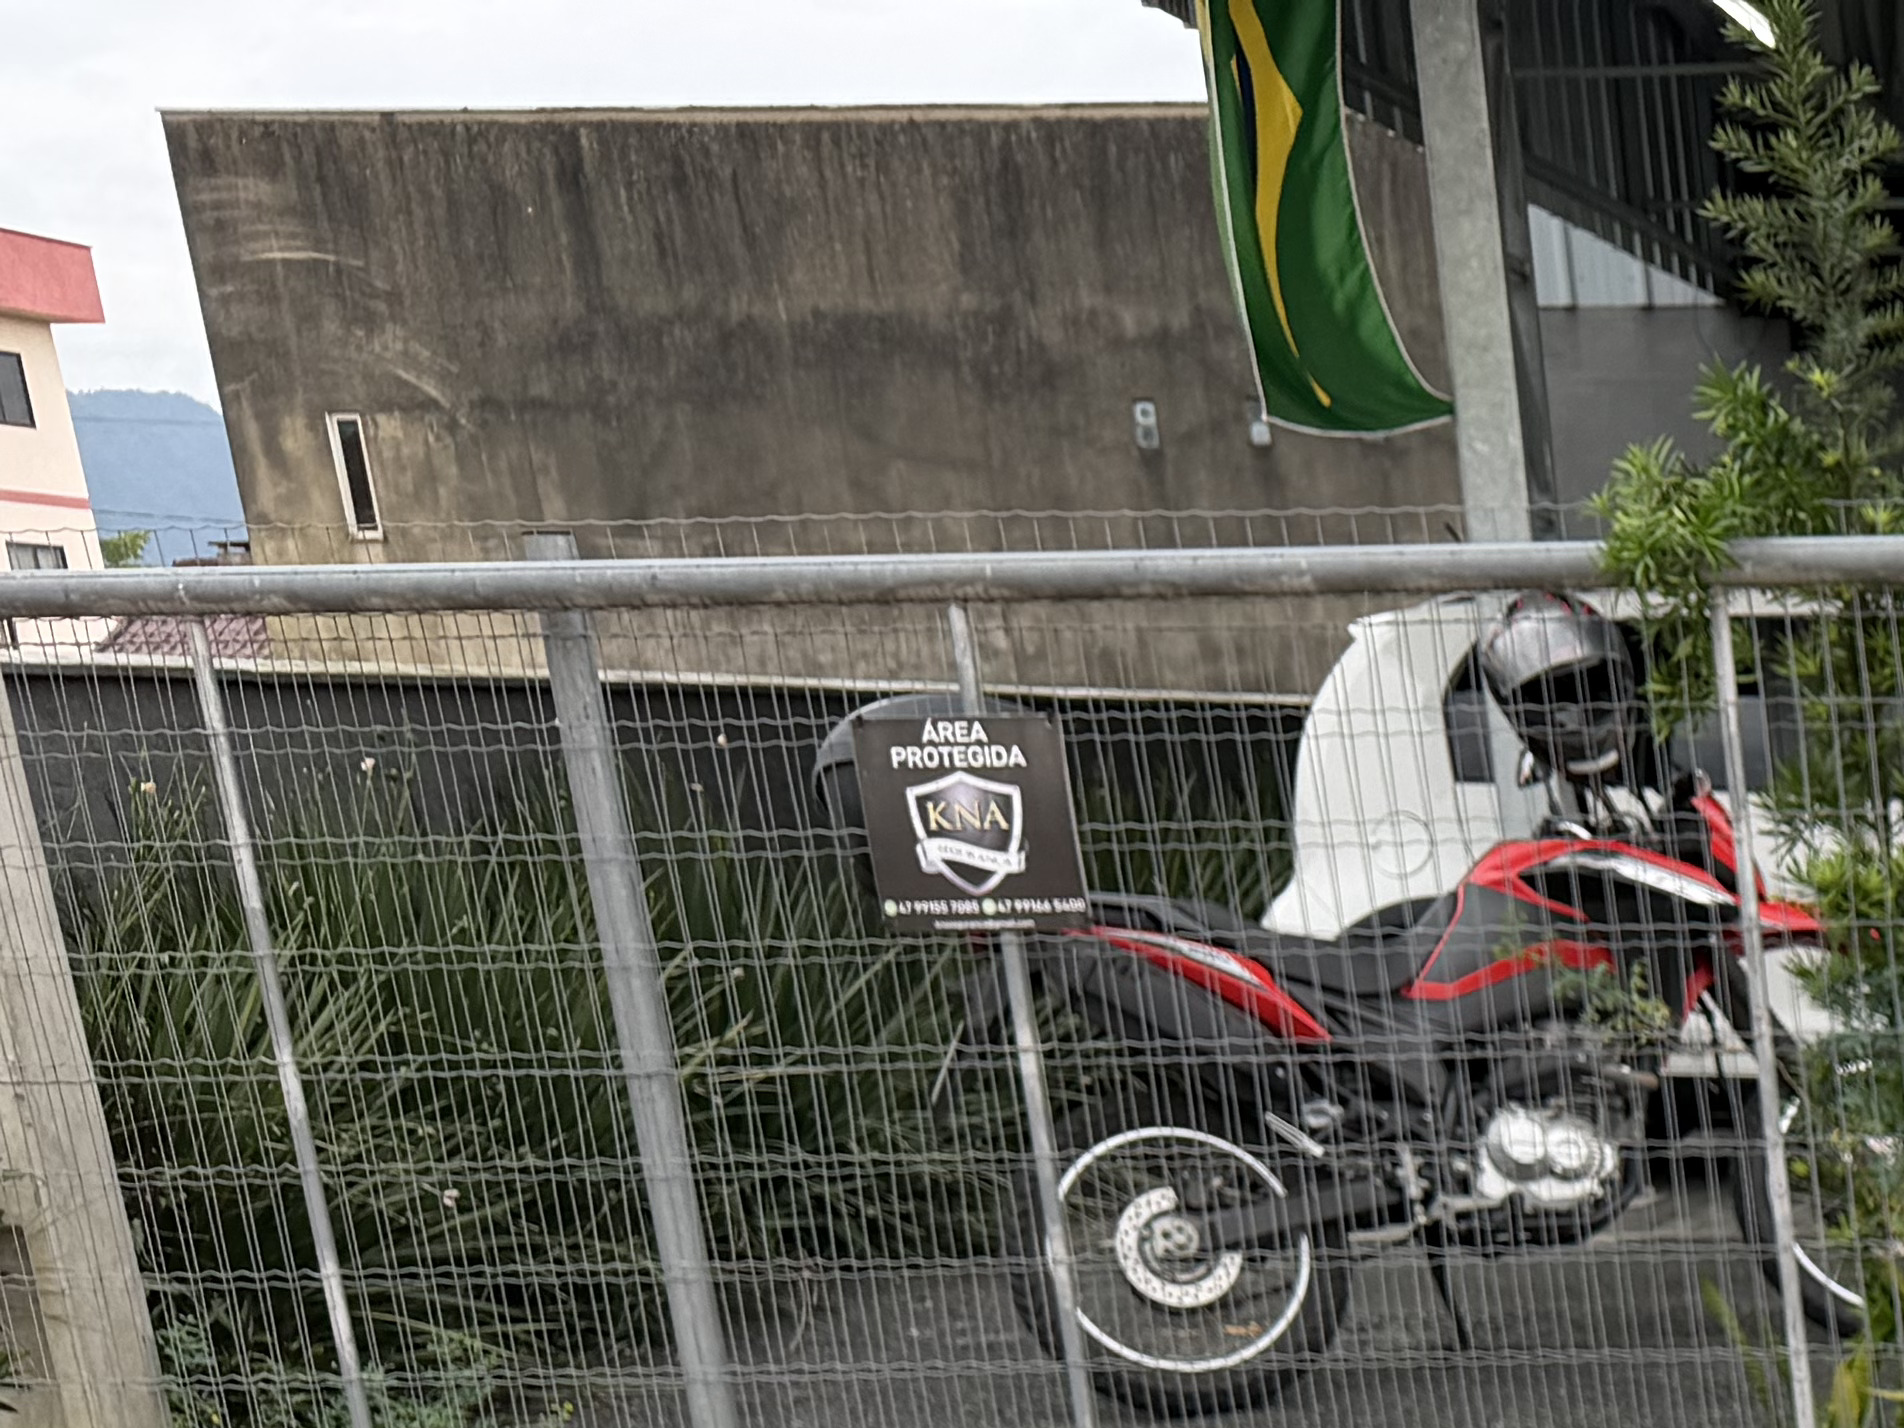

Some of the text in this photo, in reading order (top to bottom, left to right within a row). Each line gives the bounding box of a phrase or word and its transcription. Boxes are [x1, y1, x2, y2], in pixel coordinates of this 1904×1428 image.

[921, 717, 989, 744] ÁREA
[889, 744, 1028, 769] PROTEGIDA
[924, 799, 1010, 832] KNA
